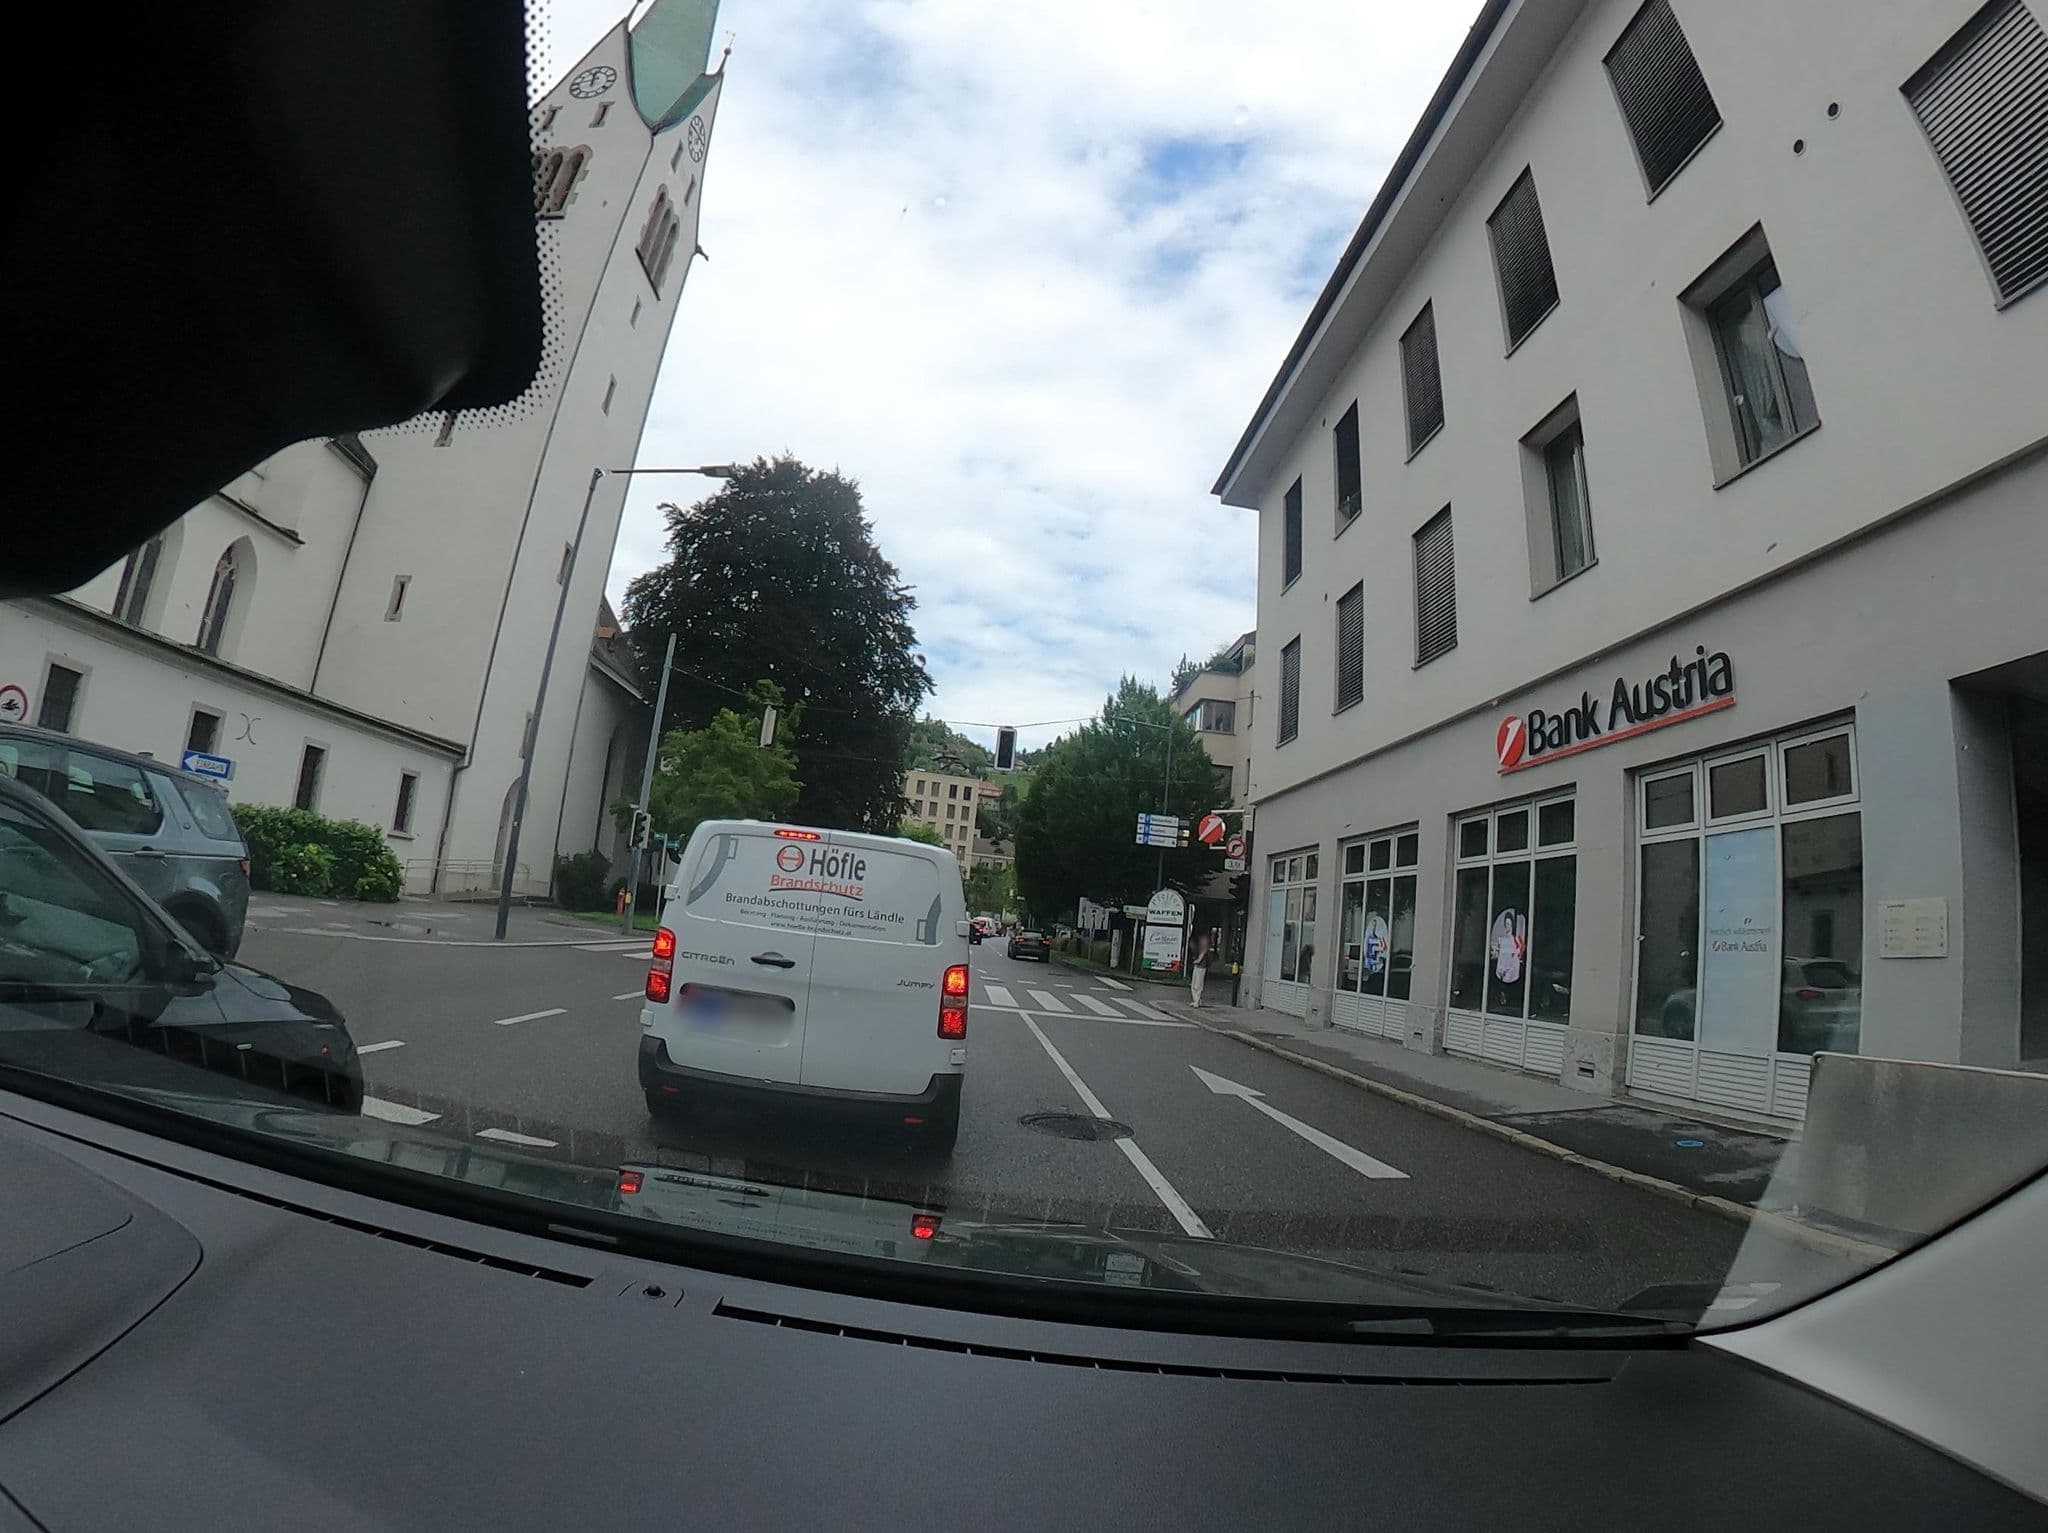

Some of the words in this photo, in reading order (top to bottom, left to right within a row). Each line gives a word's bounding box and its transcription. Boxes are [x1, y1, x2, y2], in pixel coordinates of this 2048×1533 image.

[1527, 691, 1601, 756] Bank
[1607, 644, 1734, 731] Austria
[809, 848, 867, 881] Höfle
[770, 874, 864, 897] Brandschutz
[725, 892, 841, 917] Brandabschottungen
[844, 905, 865, 919] fürs
[867, 909, 905, 924] Ländle
[1149, 909, 1183, 917] WAFFEN
[681, 950, 735, 966] CITROËN
[896, 978, 936, 990] JUMPY
